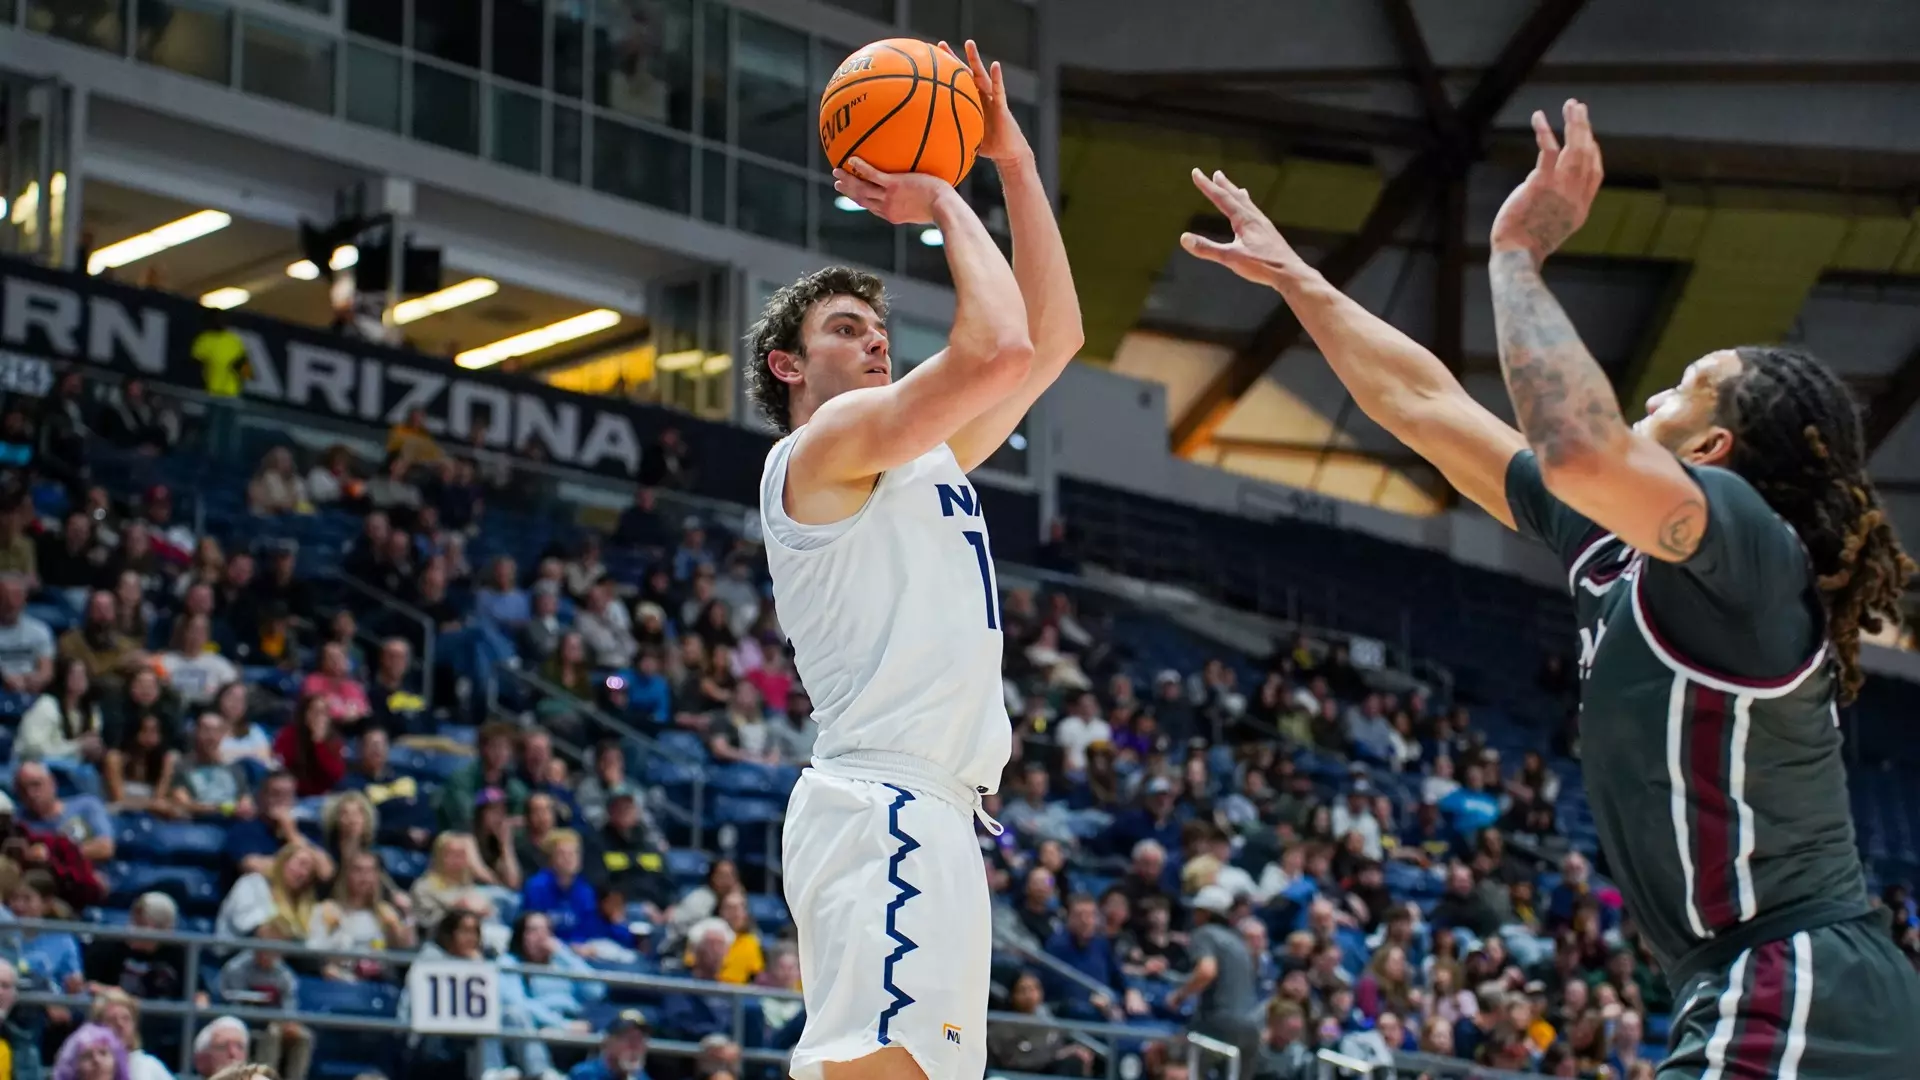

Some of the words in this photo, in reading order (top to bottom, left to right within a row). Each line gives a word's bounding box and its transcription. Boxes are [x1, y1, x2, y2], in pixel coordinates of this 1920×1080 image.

[850, 92, 868, 107] NXT
[229, 326, 641, 476] ARIZONA
[934, 484, 981, 517] N
[428, 975, 487, 1018] 116
